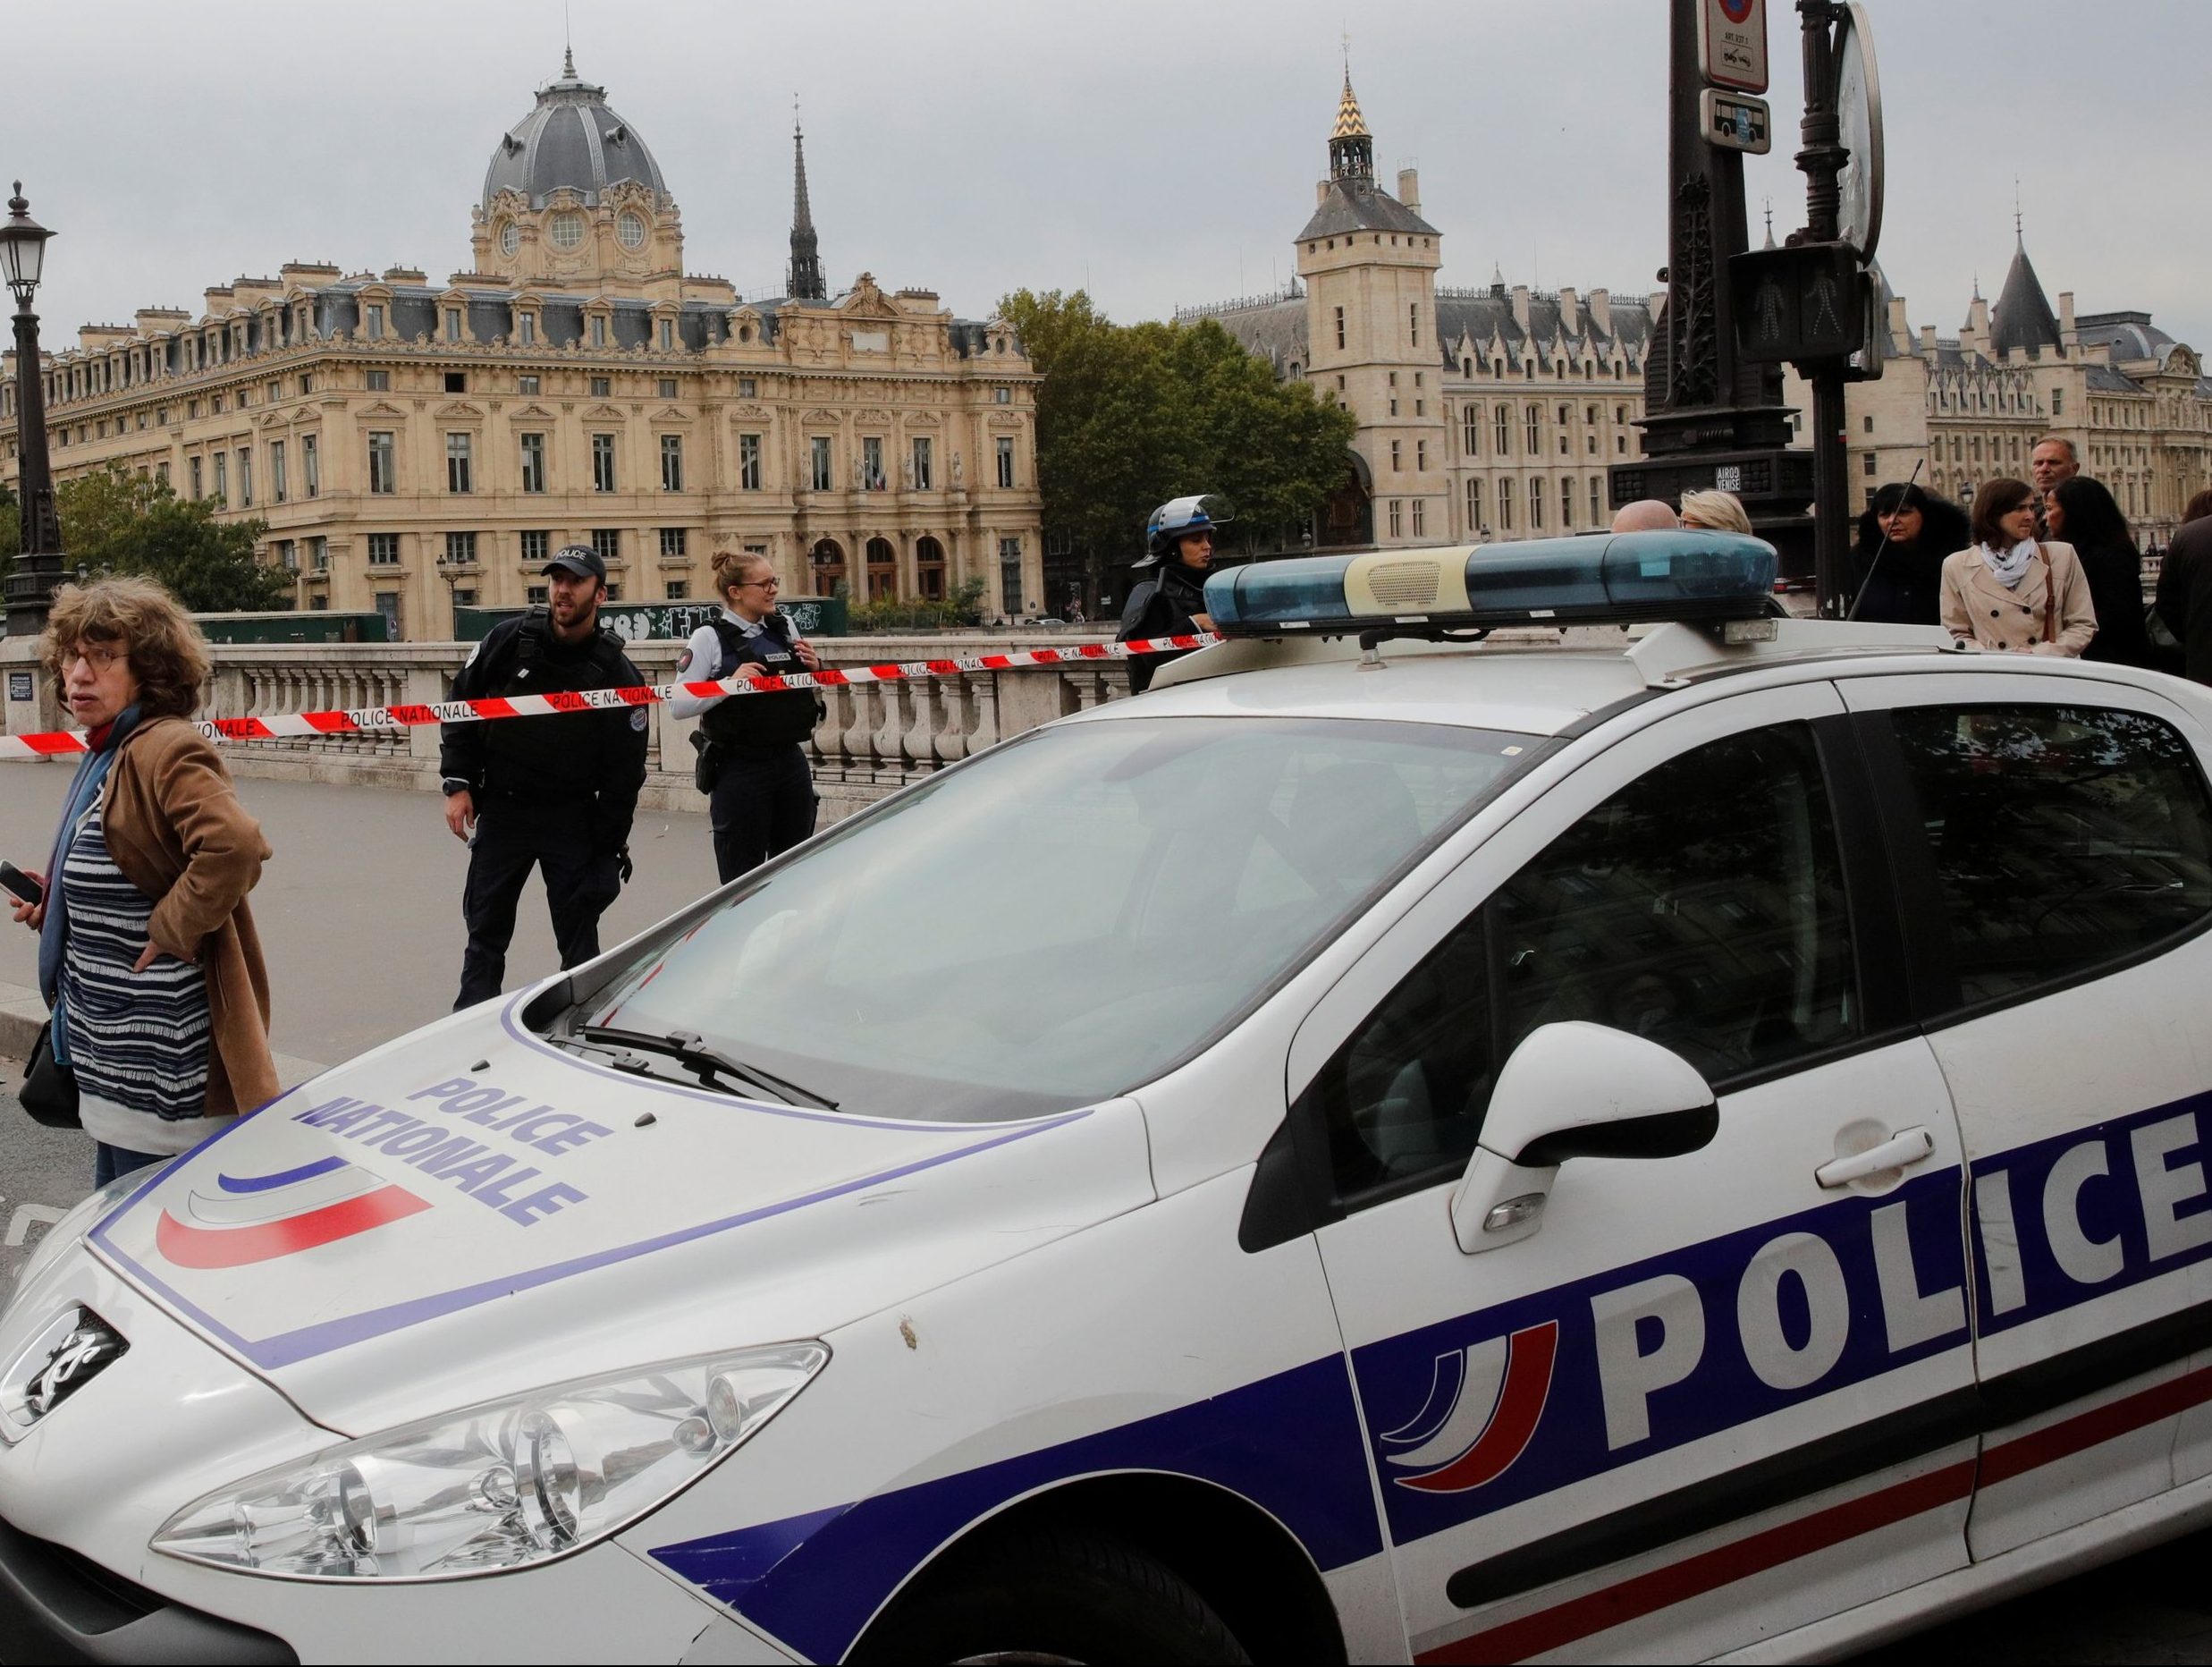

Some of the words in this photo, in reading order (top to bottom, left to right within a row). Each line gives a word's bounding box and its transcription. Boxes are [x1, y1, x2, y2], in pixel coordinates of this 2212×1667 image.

[1717, 478, 1741, 491] VENISE
[555, 549, 587, 561] POLICE
[198, 719, 256, 739] ONALE
[341, 709, 393, 727] POLICE
[398, 704, 477, 722] NATIONALE
[553, 692, 598, 709] POLICE
[603, 686, 672, 704] NATIONALE
[737, 677, 777, 692] POLICE
[781, 672, 841, 688] NATIONALE
[897, 663, 933, 675] POLICE
[934, 656, 989, 673] NATIONALE
[1037, 649, 1070, 661] POLICE
[406, 1078, 615, 1157] POLICE
[291, 1096, 590, 1227] NATIONALE
[1590, 1112, 2212, 1451] POLICE
